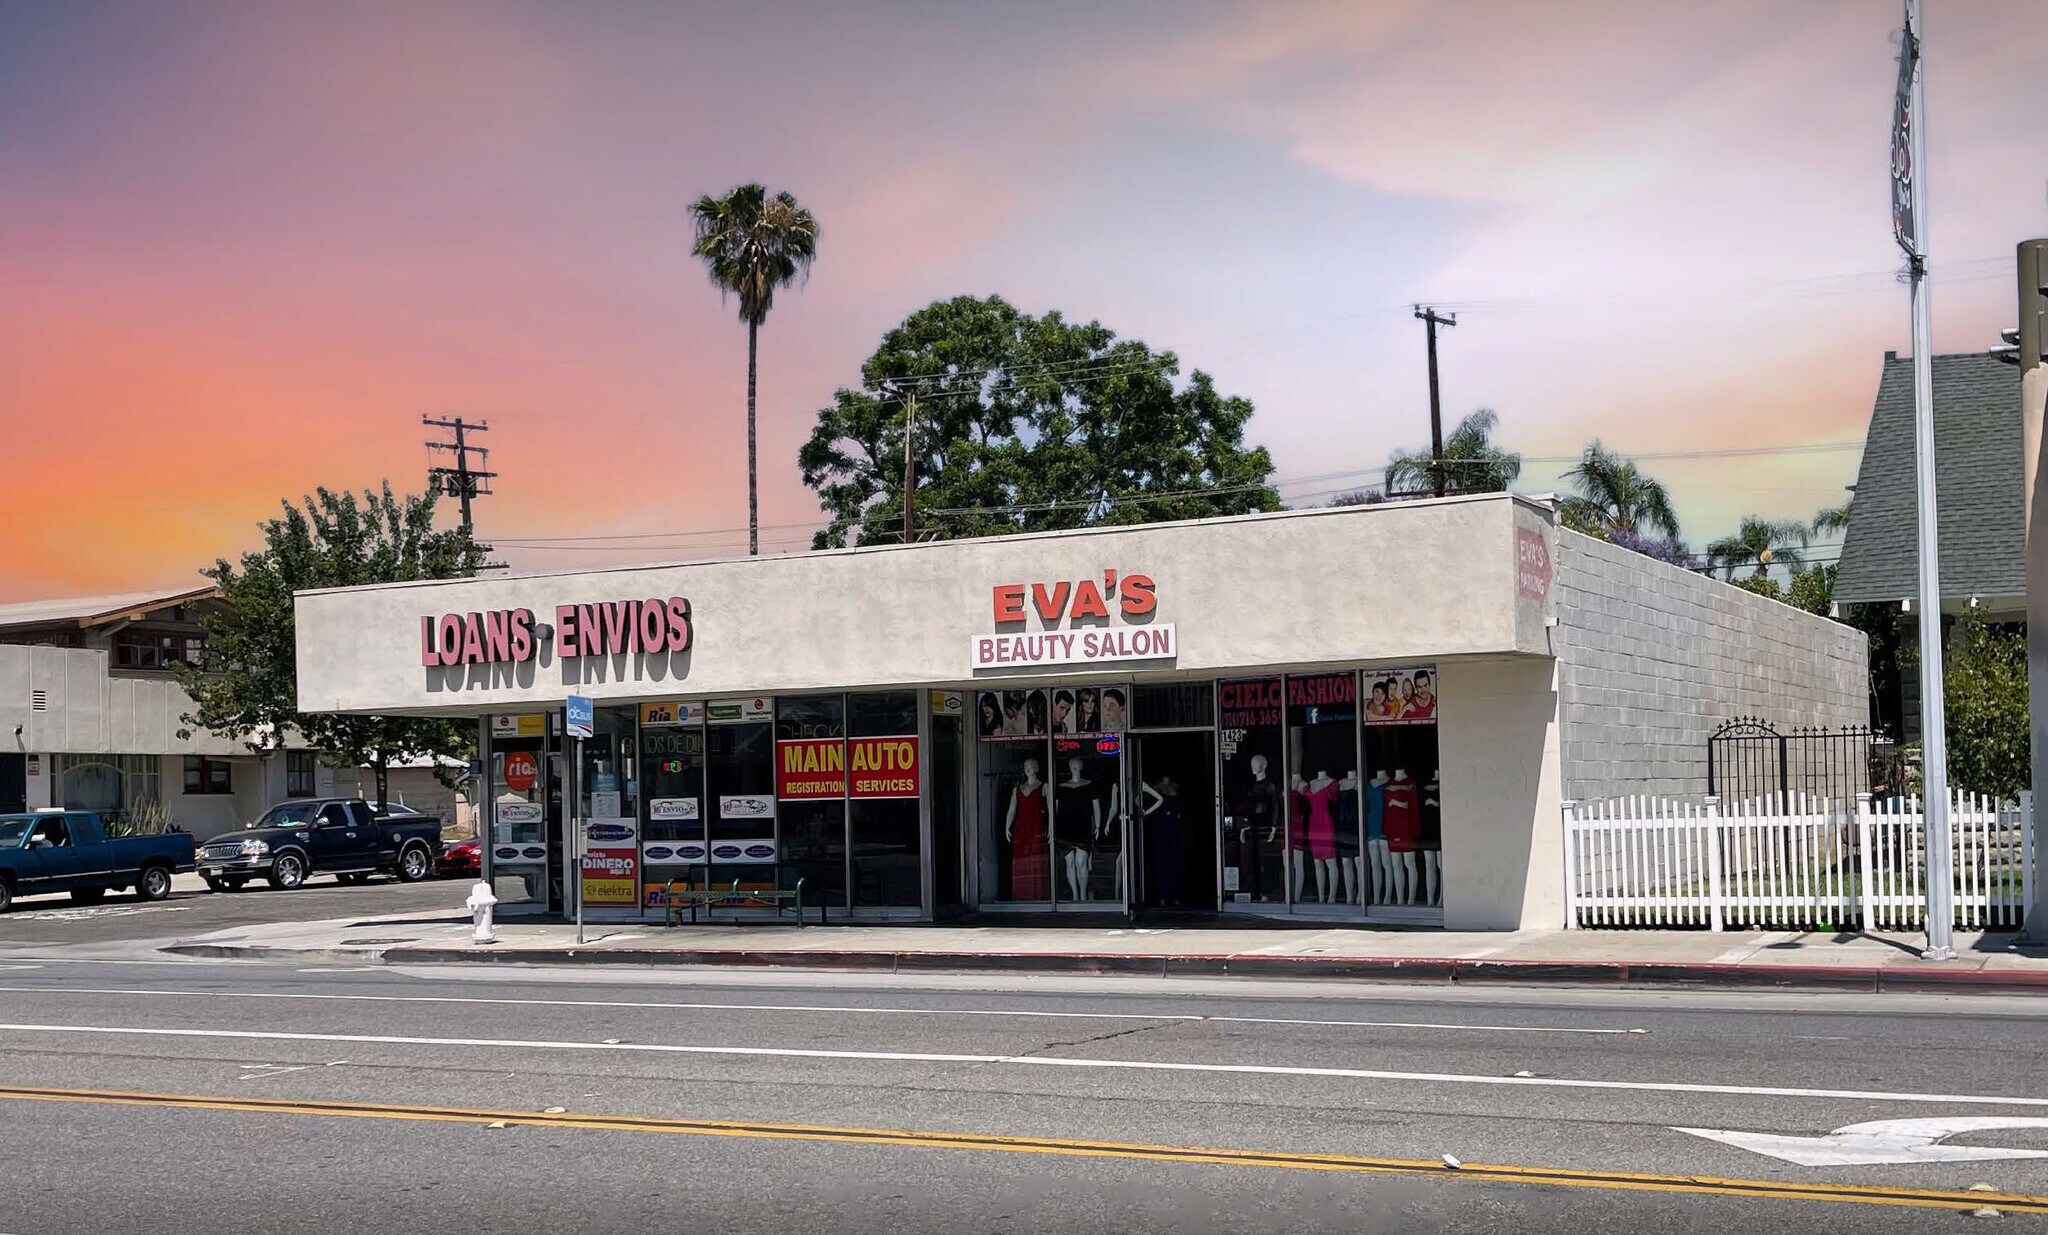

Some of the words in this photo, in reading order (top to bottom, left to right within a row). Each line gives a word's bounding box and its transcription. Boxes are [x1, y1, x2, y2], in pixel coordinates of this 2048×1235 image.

[993, 569, 1157, 623] EVA'S
[421, 608, 536, 666] LOANS
[556, 597, 692, 657] ENVIOS
[979, 635, 1075, 664] BEAUTY
[1083, 629, 1170, 658] SALON
[1288, 677, 1356, 706] FASHION
[1222, 730, 1243, 741] 1423
[508, 757, 533, 776] ria
[784, 744, 843, 773] MAIN
[852, 742, 914, 771] AUTO
[786, 780, 845, 794] REGISTRATION
[856, 779, 914, 793] SERVICES
[583, 858, 635, 869] DINERO
[597, 885, 633, 897] elektra
